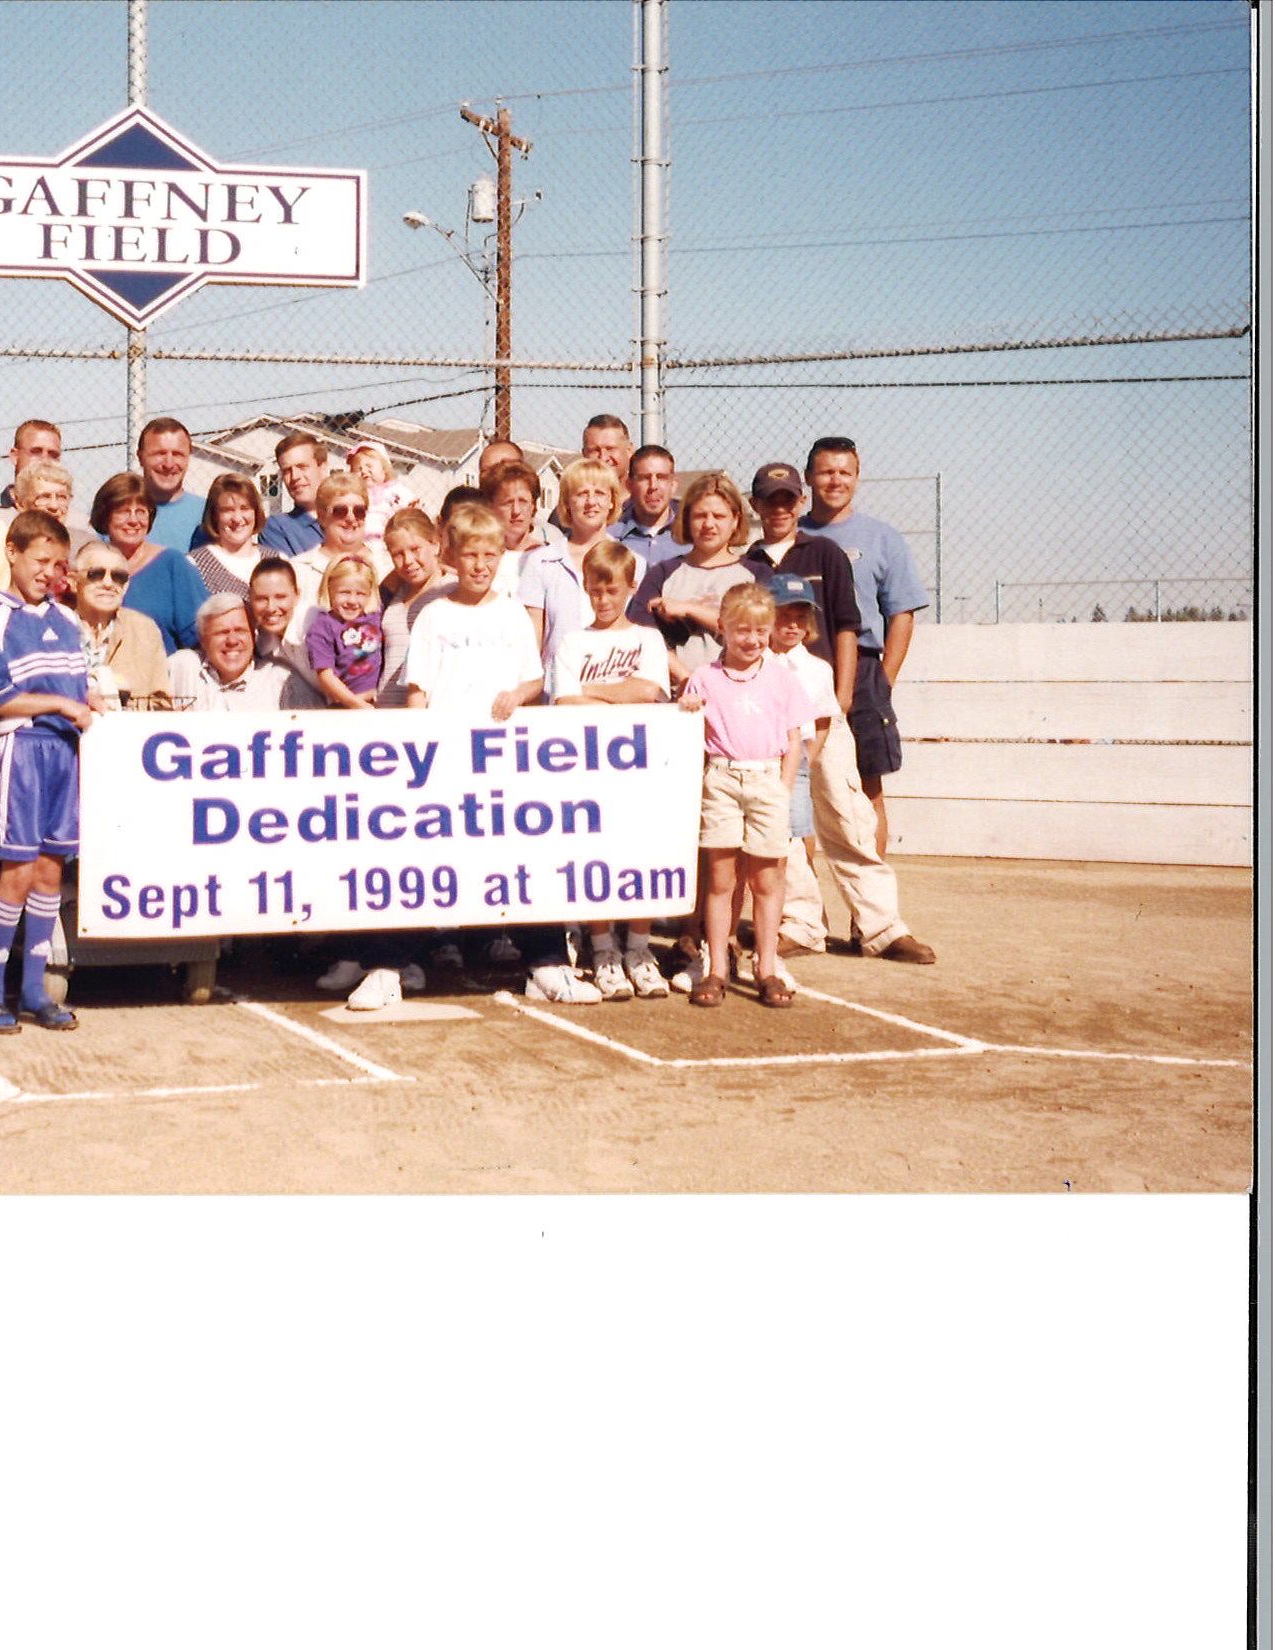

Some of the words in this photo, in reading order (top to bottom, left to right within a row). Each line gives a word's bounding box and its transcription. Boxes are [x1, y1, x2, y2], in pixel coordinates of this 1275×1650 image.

[37, 223, 242, 265] FIELD
[141, 730, 439, 789] Gaffney
[470, 724, 648, 774] Field
[192, 789, 602, 845] Dedication
[101, 872, 222, 929] Sept
[248, 870, 312, 922] 11,
[339, 865, 458, 911] 1999
[484, 864, 532, 907] at
[556, 860, 686, 903] 10am
